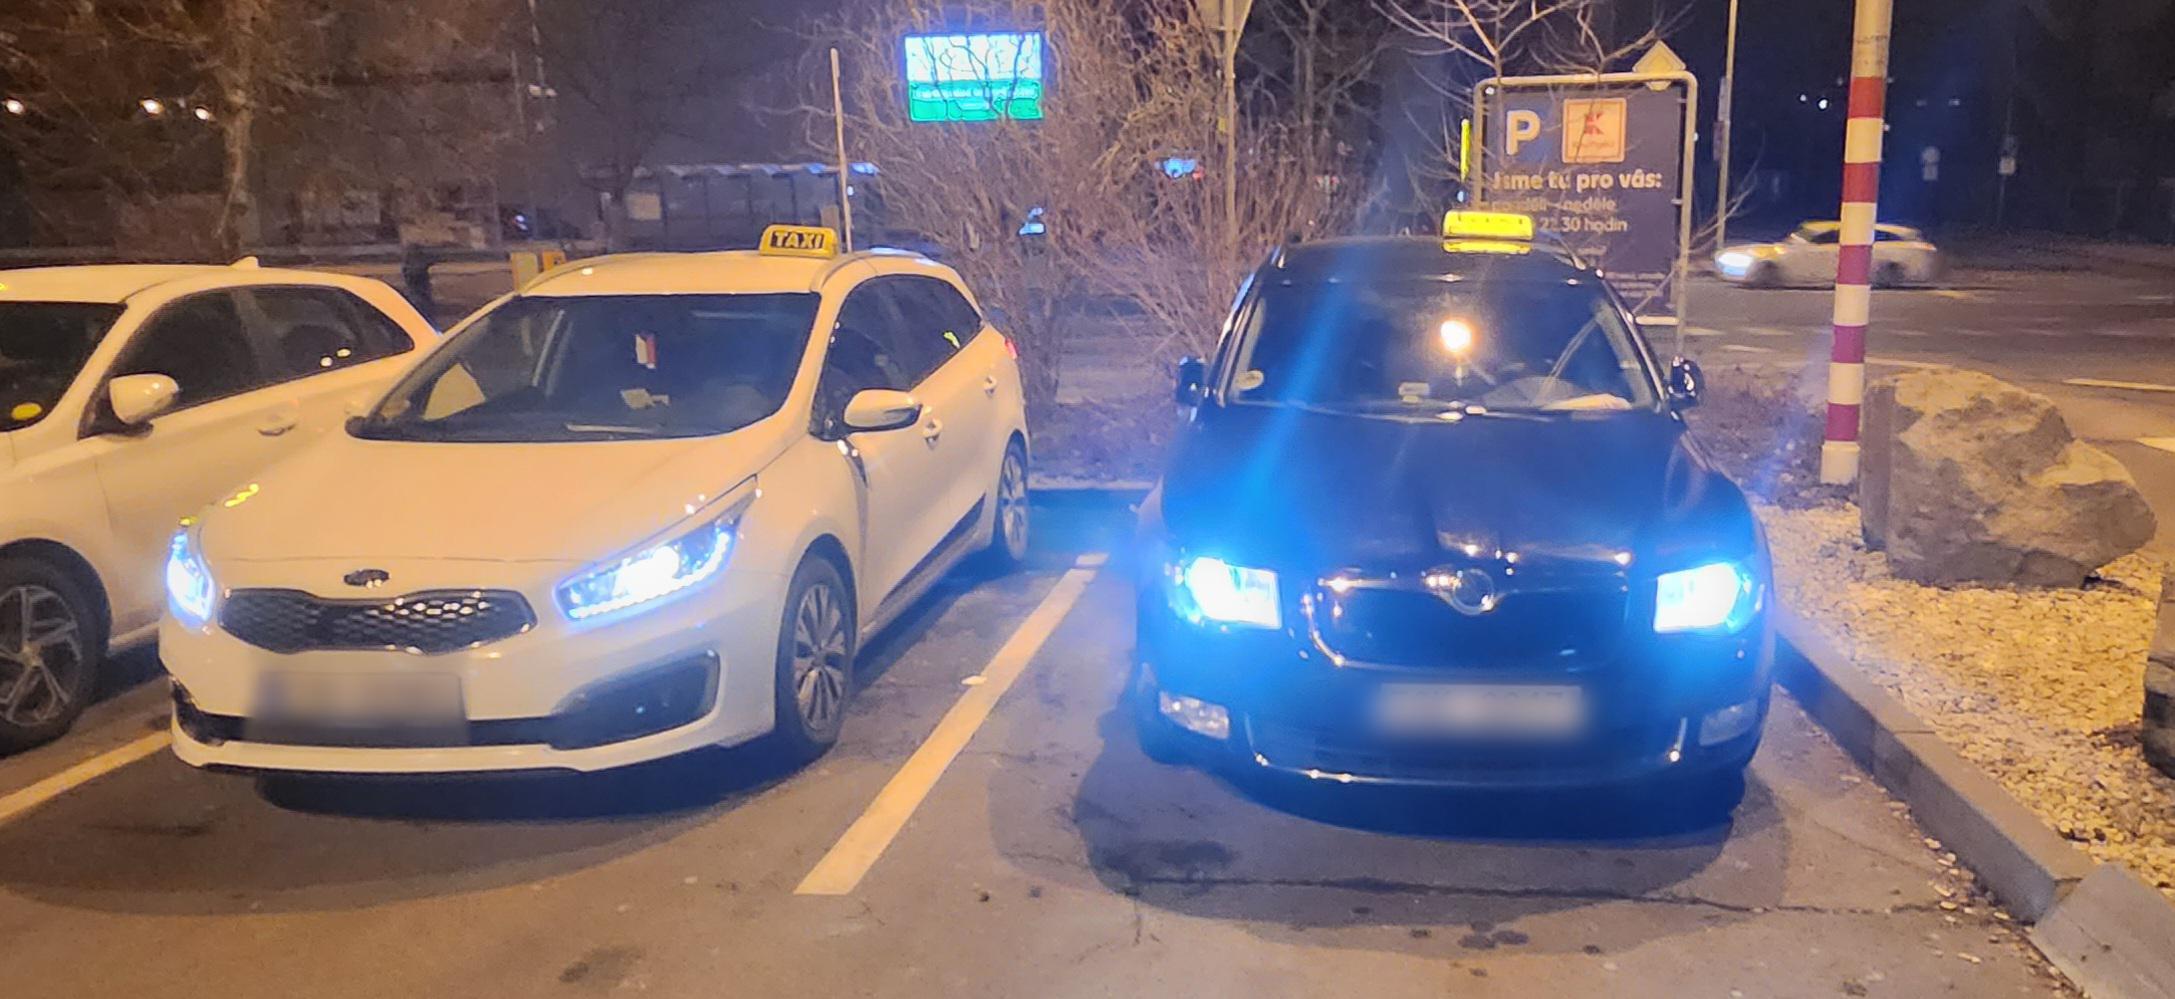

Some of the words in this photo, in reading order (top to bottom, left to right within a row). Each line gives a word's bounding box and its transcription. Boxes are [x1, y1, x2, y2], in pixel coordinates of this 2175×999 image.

[1506, 110, 1541, 155] P
[1492, 170, 1543, 190] Jsme
[1548, 170, 1571, 189] tu
[1576, 173, 1614, 193] pro
[1618, 168, 1662, 188] vás:
[1584, 215, 1628, 233] hodin
[771, 230, 825, 249] TAXI
